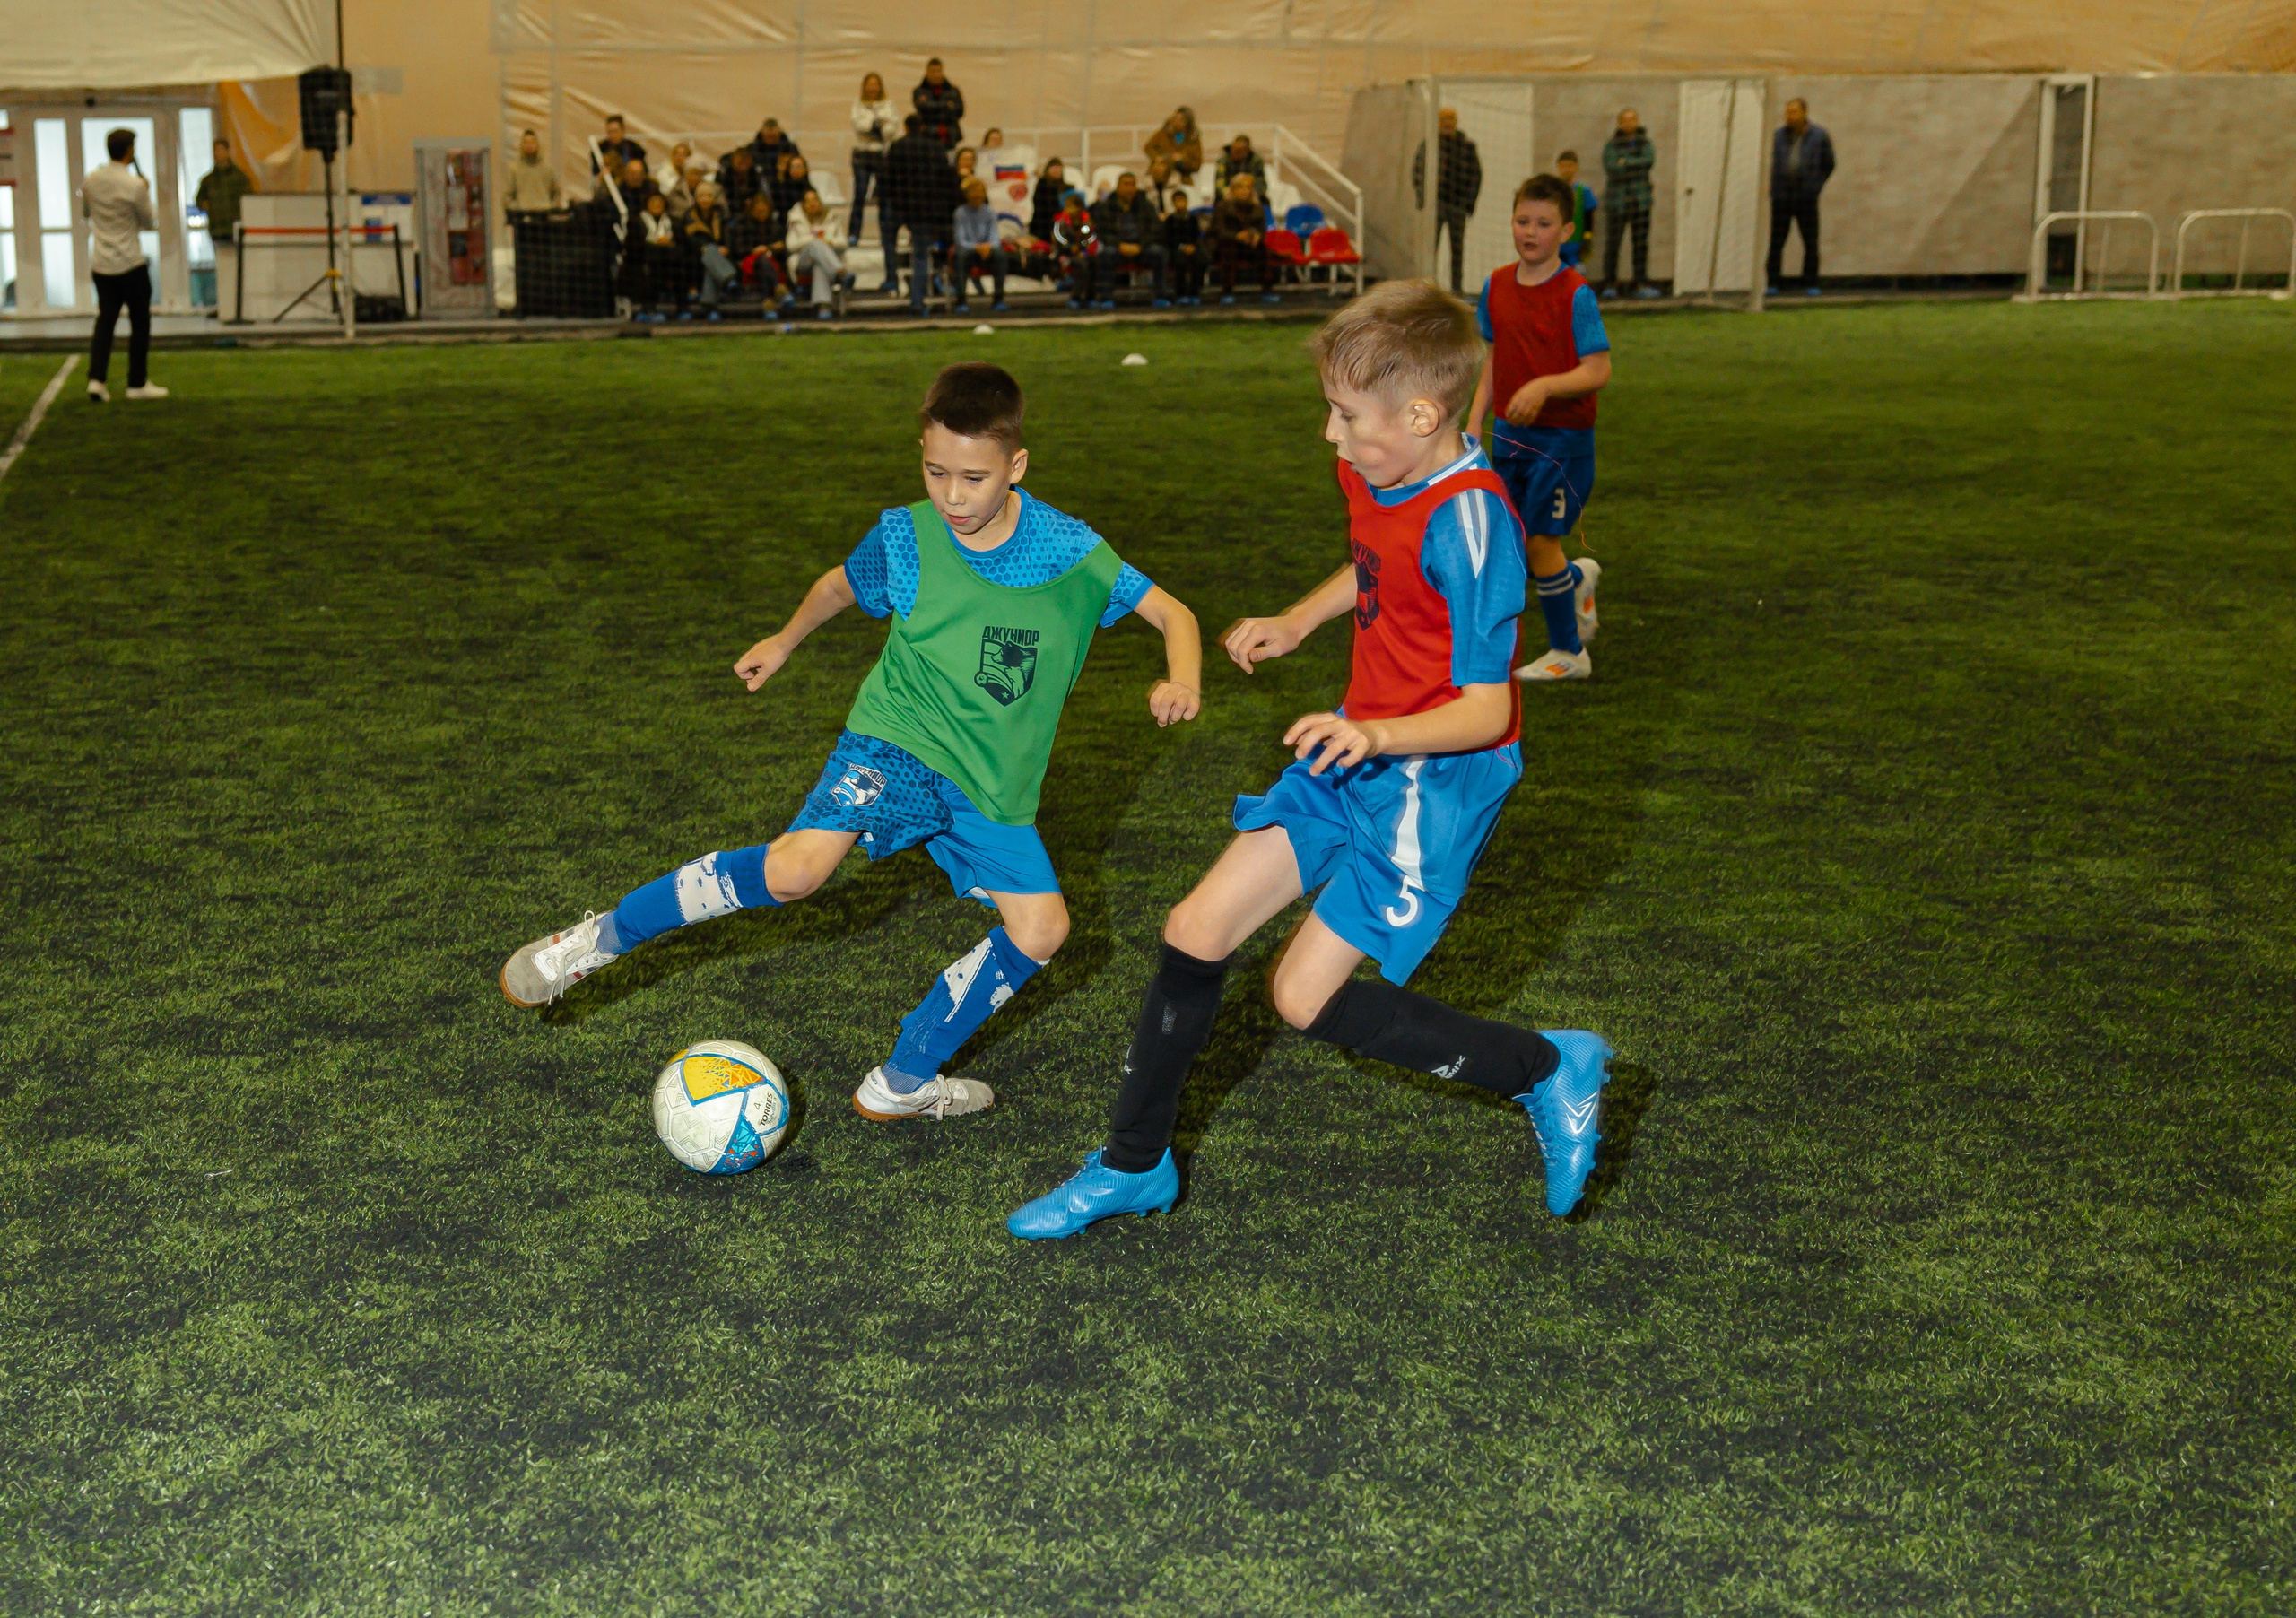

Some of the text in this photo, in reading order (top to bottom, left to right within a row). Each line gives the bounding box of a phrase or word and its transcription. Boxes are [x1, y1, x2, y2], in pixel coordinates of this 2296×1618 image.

[1552, 488, 1566, 519] 3
[982, 625, 1040, 647] ДЖУНИОР
[1386, 874, 1424, 927] 5
[753, 1102, 761, 1110] 4
[759, 1092, 773, 1126] TORRES
